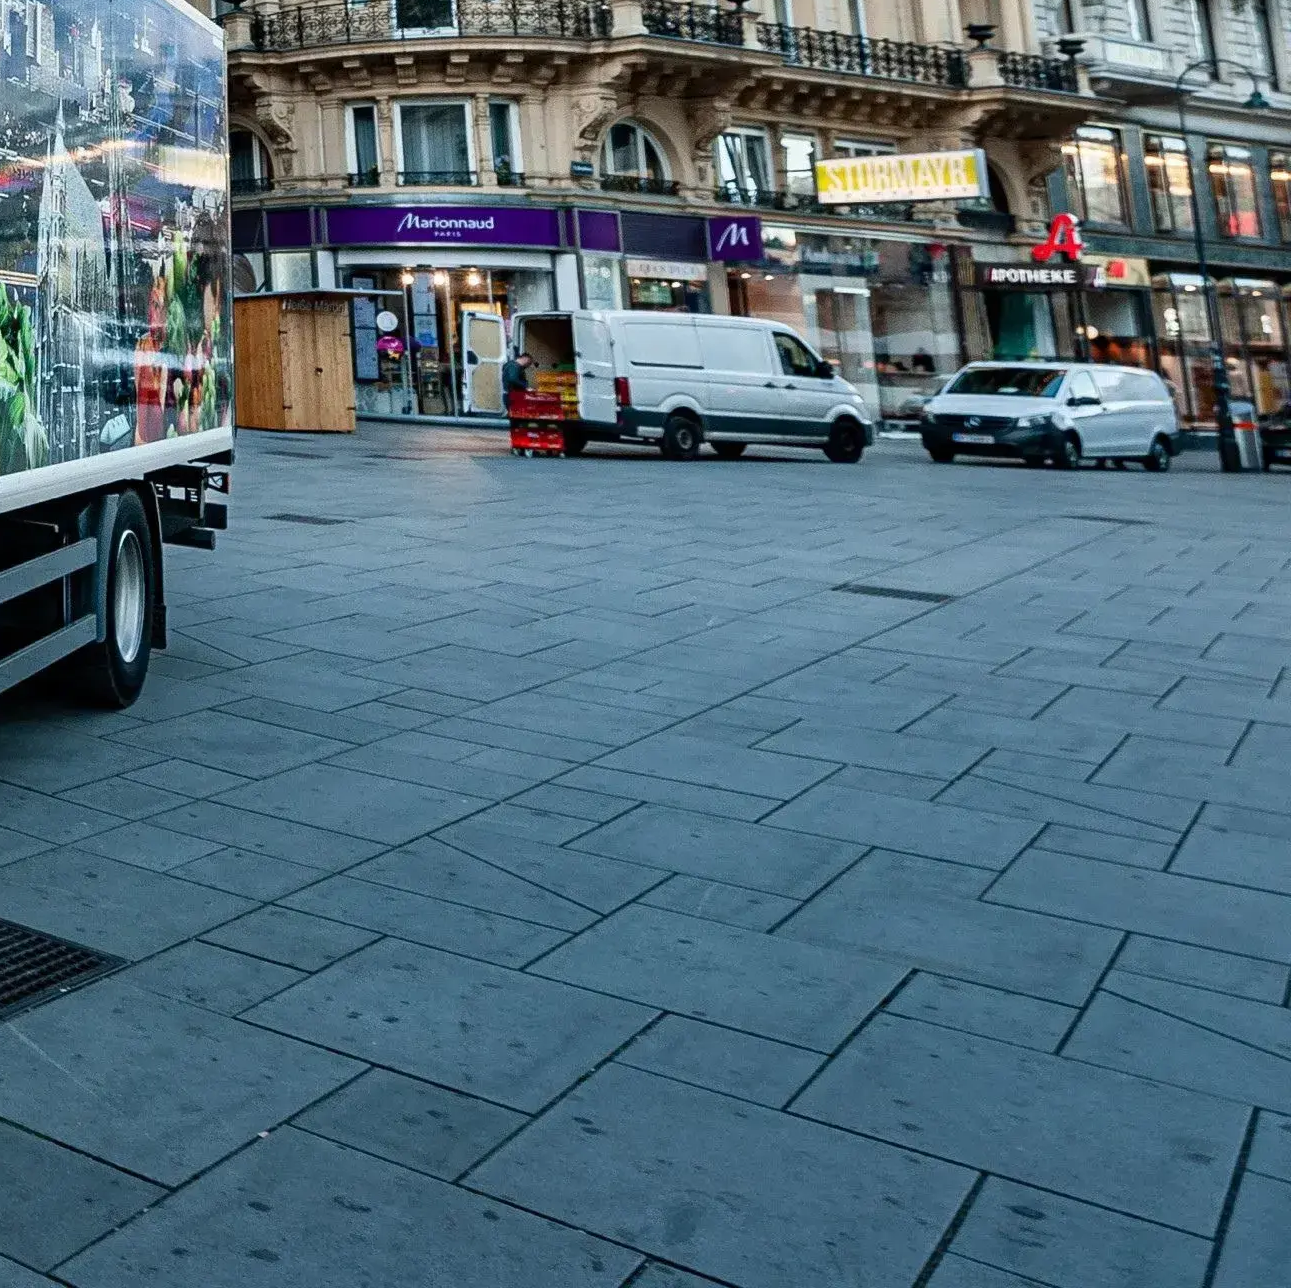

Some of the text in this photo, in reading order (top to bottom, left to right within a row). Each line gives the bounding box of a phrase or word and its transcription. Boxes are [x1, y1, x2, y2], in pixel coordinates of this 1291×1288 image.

[826, 158, 968, 193] STURMAYR
[397, 212, 495, 232] Marionnaud
[990, 267, 1077, 284] APOTHEKE
